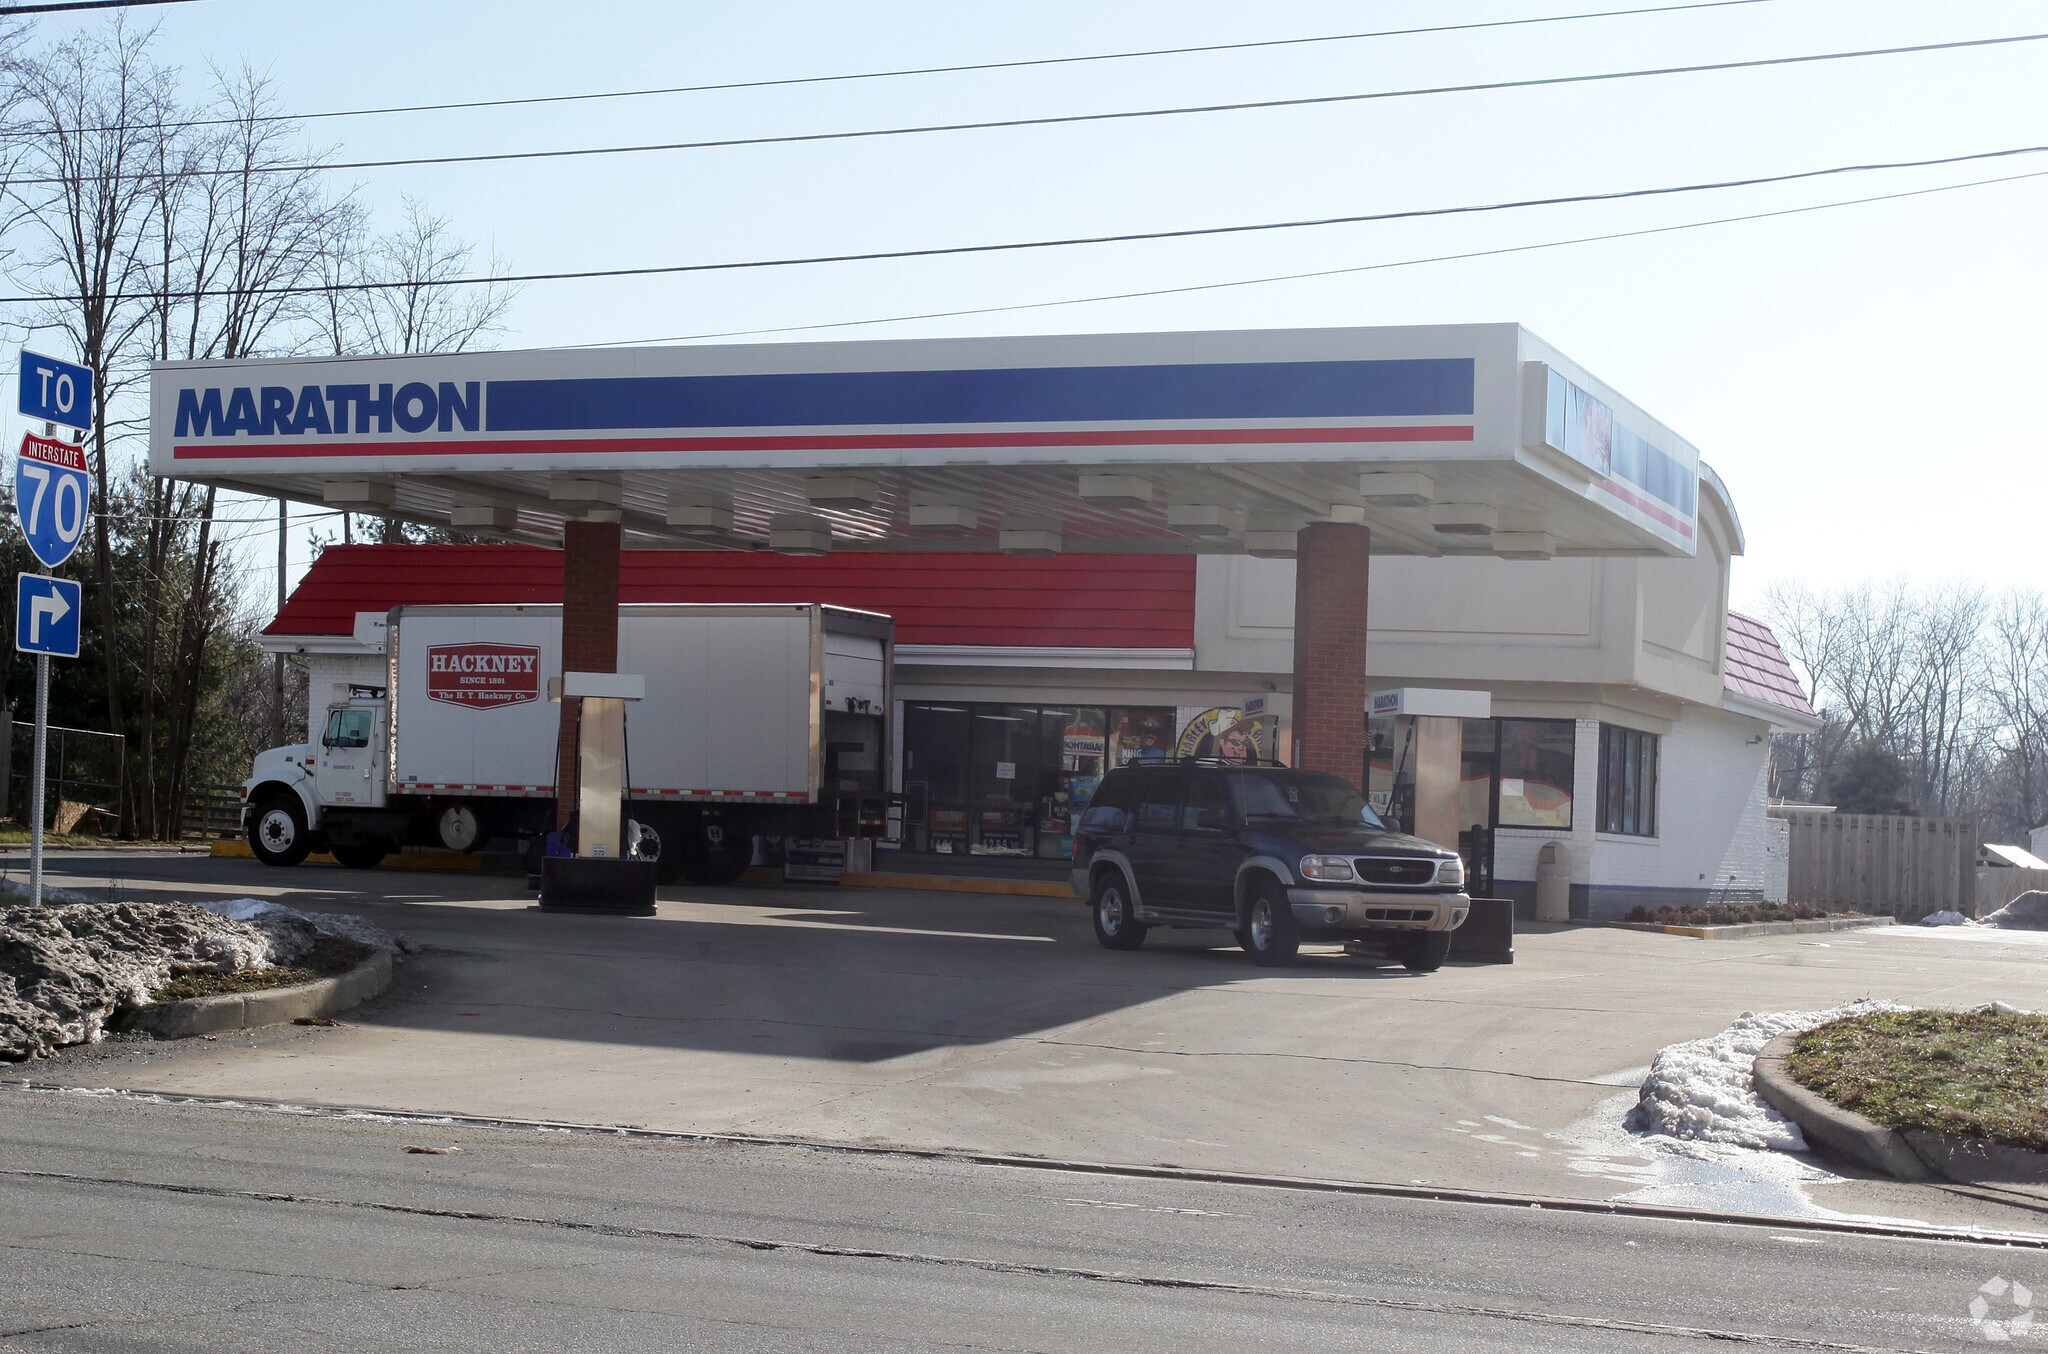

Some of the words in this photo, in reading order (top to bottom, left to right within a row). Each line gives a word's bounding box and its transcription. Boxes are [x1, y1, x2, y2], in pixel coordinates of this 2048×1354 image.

[36, 366, 75, 414] TO
[173, 381, 481, 437] MARATHON
[28, 440, 80, 468] INTERSTATE
[23, 464, 82, 544] 70
[430, 654, 536, 673] HACKNEY
[459, 676, 486, 684] SINCE
[488, 677, 505, 685] 1891
[439, 691, 454, 699] The
[478, 692, 512, 701] Hackney
[514, 692, 528, 700] Co.
[1180, 717, 1208, 757] HARLEY
[1122, 748, 1142, 759] KING
